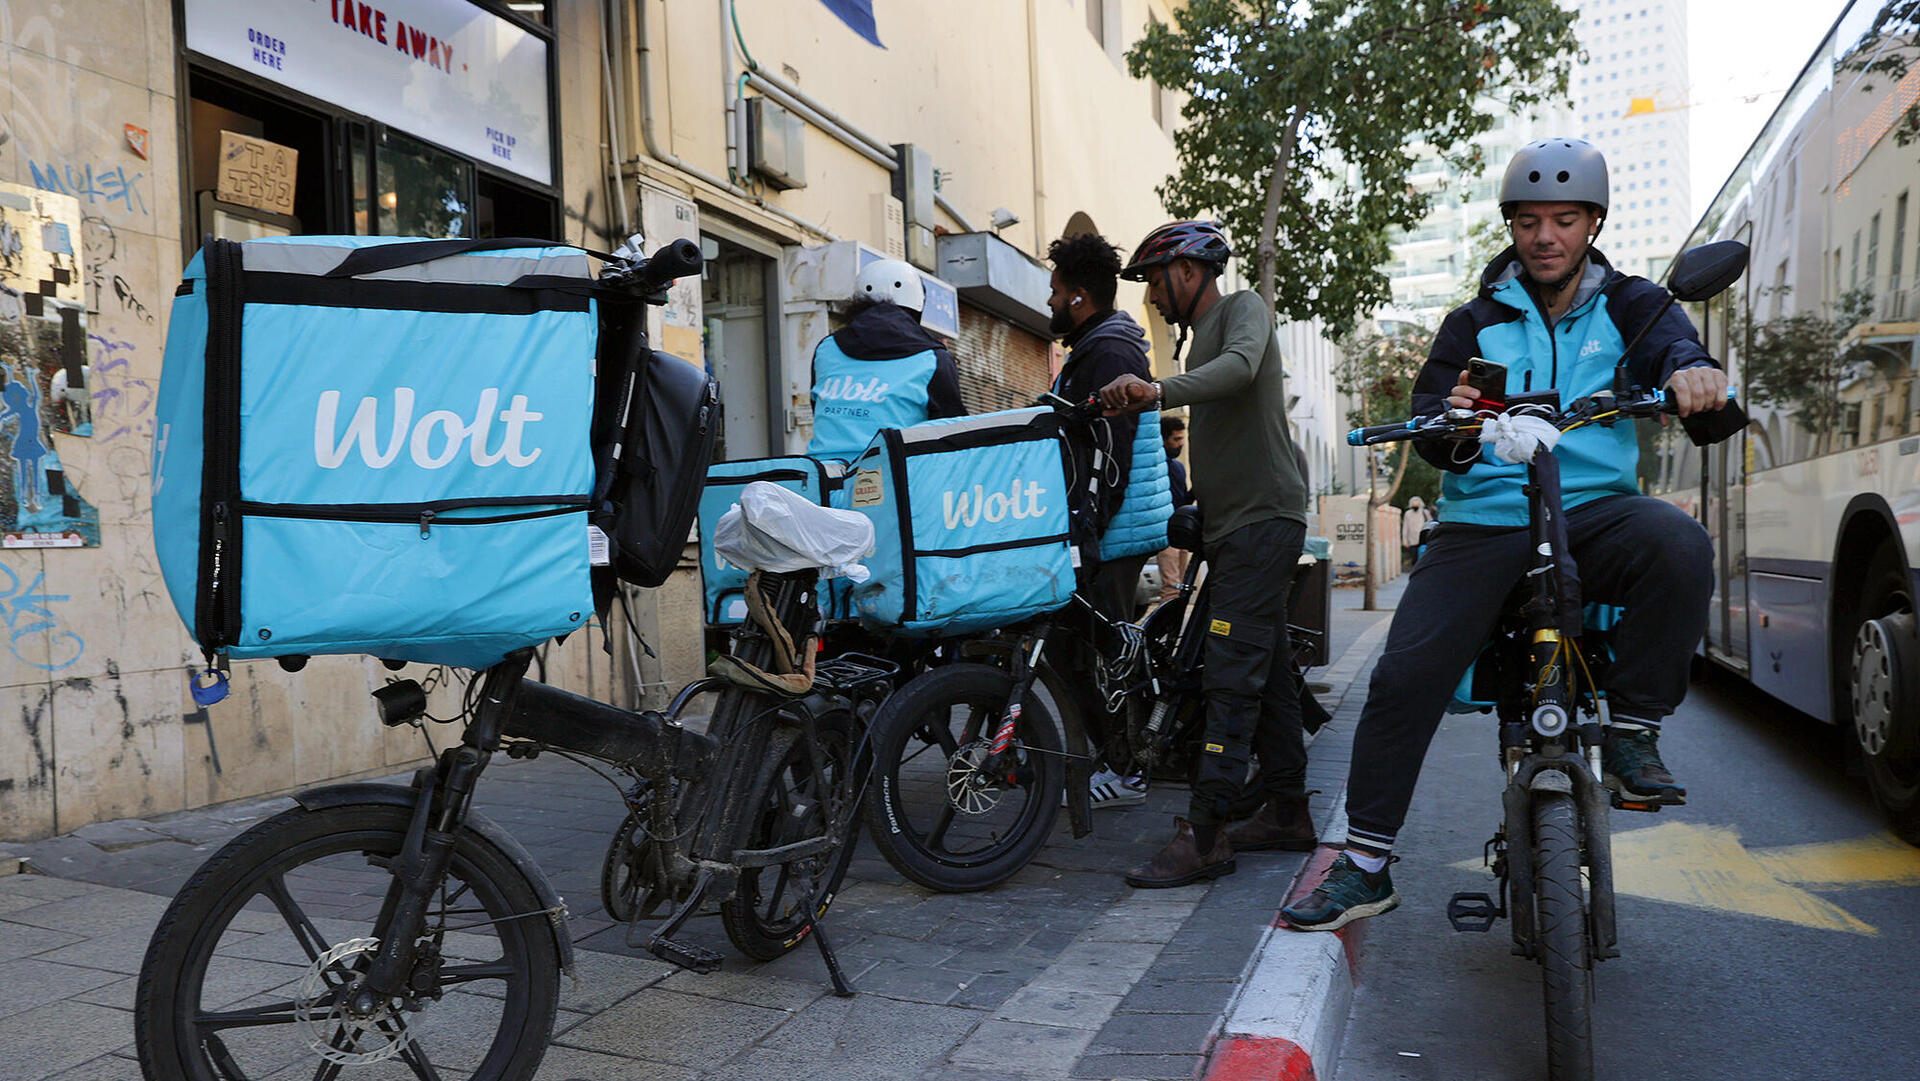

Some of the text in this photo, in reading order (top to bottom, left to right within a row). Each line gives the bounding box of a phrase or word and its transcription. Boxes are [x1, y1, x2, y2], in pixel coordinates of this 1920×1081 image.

[247, 28, 286, 55] ORDER
[331, 0, 453, 74] TAKE AWAY
[252, 47, 283, 71] HERE
[486, 127, 516, 147] PICK UP
[492, 143, 513, 161] HERE
[819, 375, 889, 403] Wolt
[823, 406, 870, 418] PARTNER
[314, 387, 544, 470] Wolt
[943, 478, 1048, 530] Wolt
